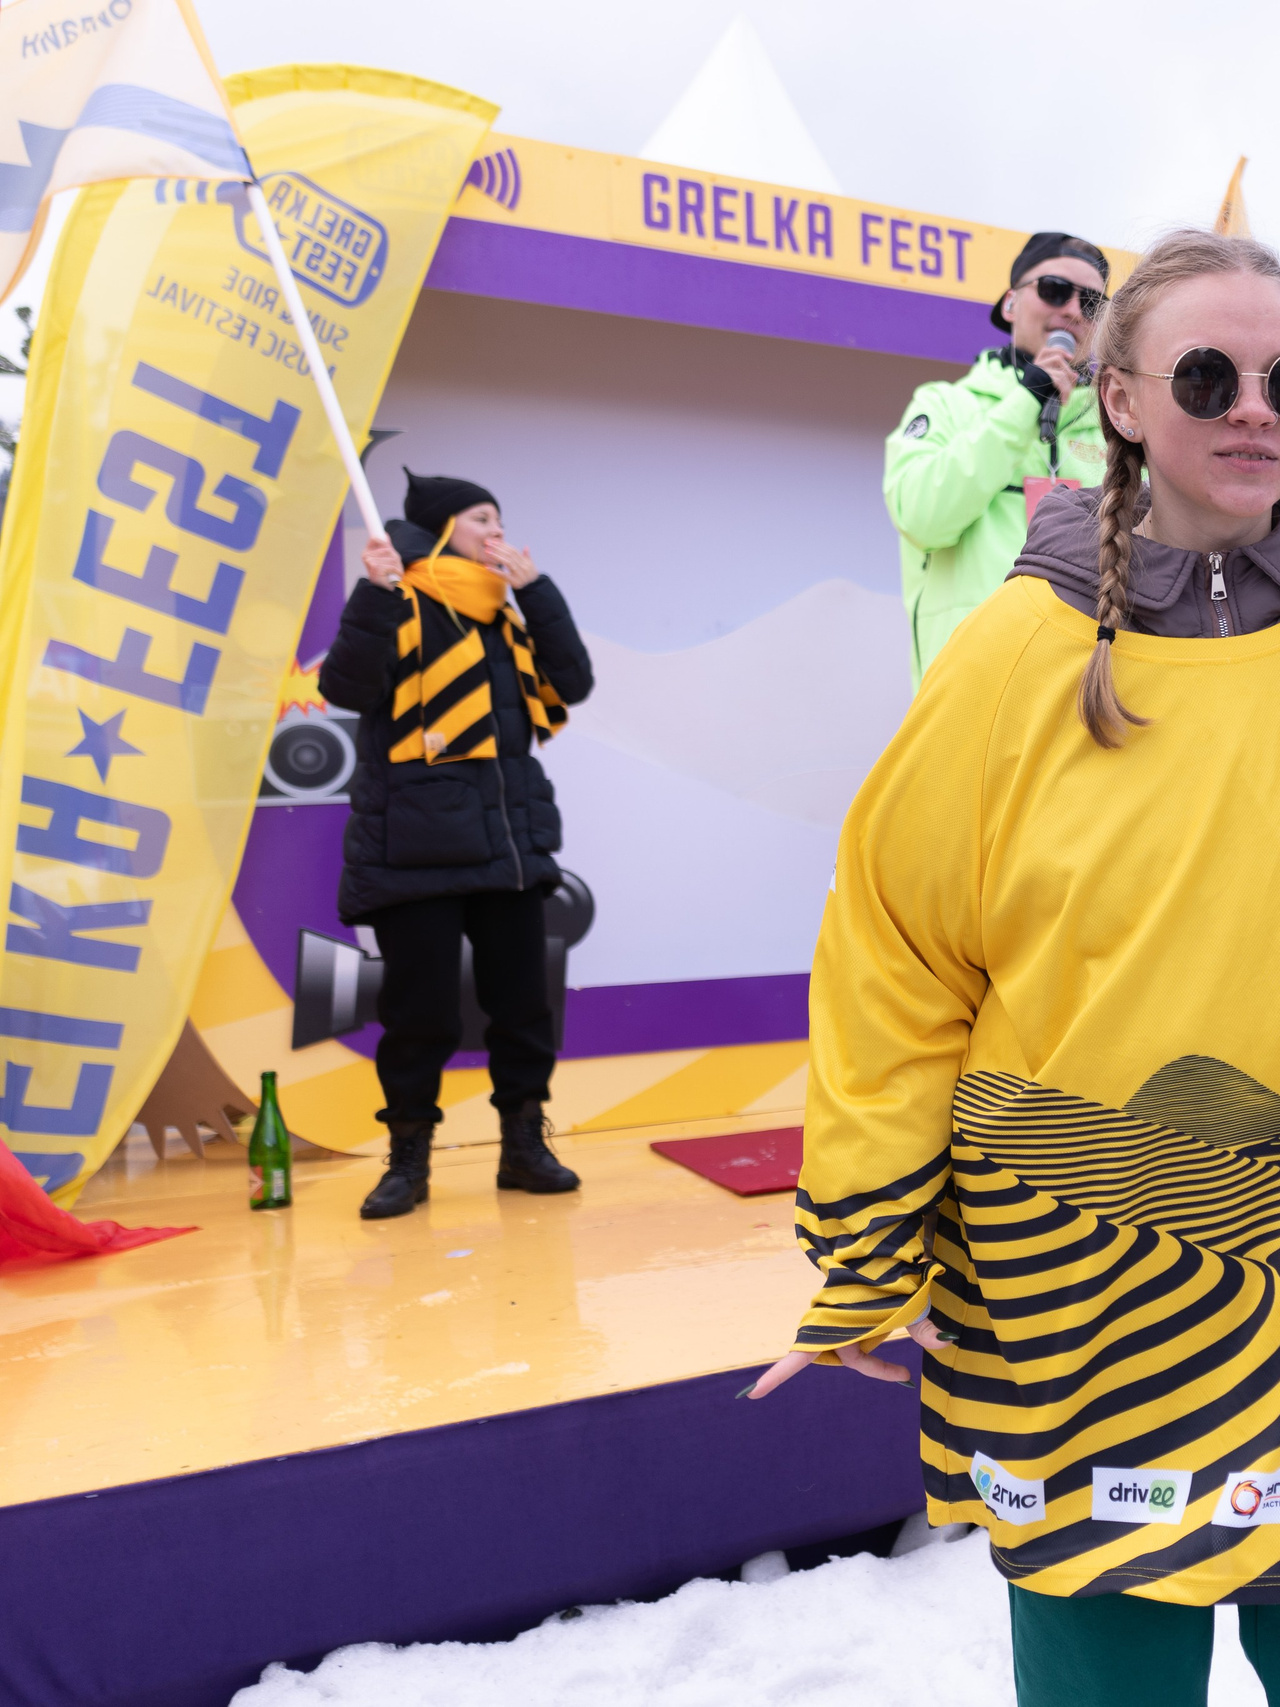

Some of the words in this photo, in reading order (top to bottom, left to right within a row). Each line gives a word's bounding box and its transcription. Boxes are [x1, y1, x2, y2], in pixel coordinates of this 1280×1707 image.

[642, 172, 834, 260] GRELKA
[860, 211, 973, 282] FEST
[992, 1483, 1037, 1509] 2ГИС
[1109, 1482, 1175, 1508] drivee
